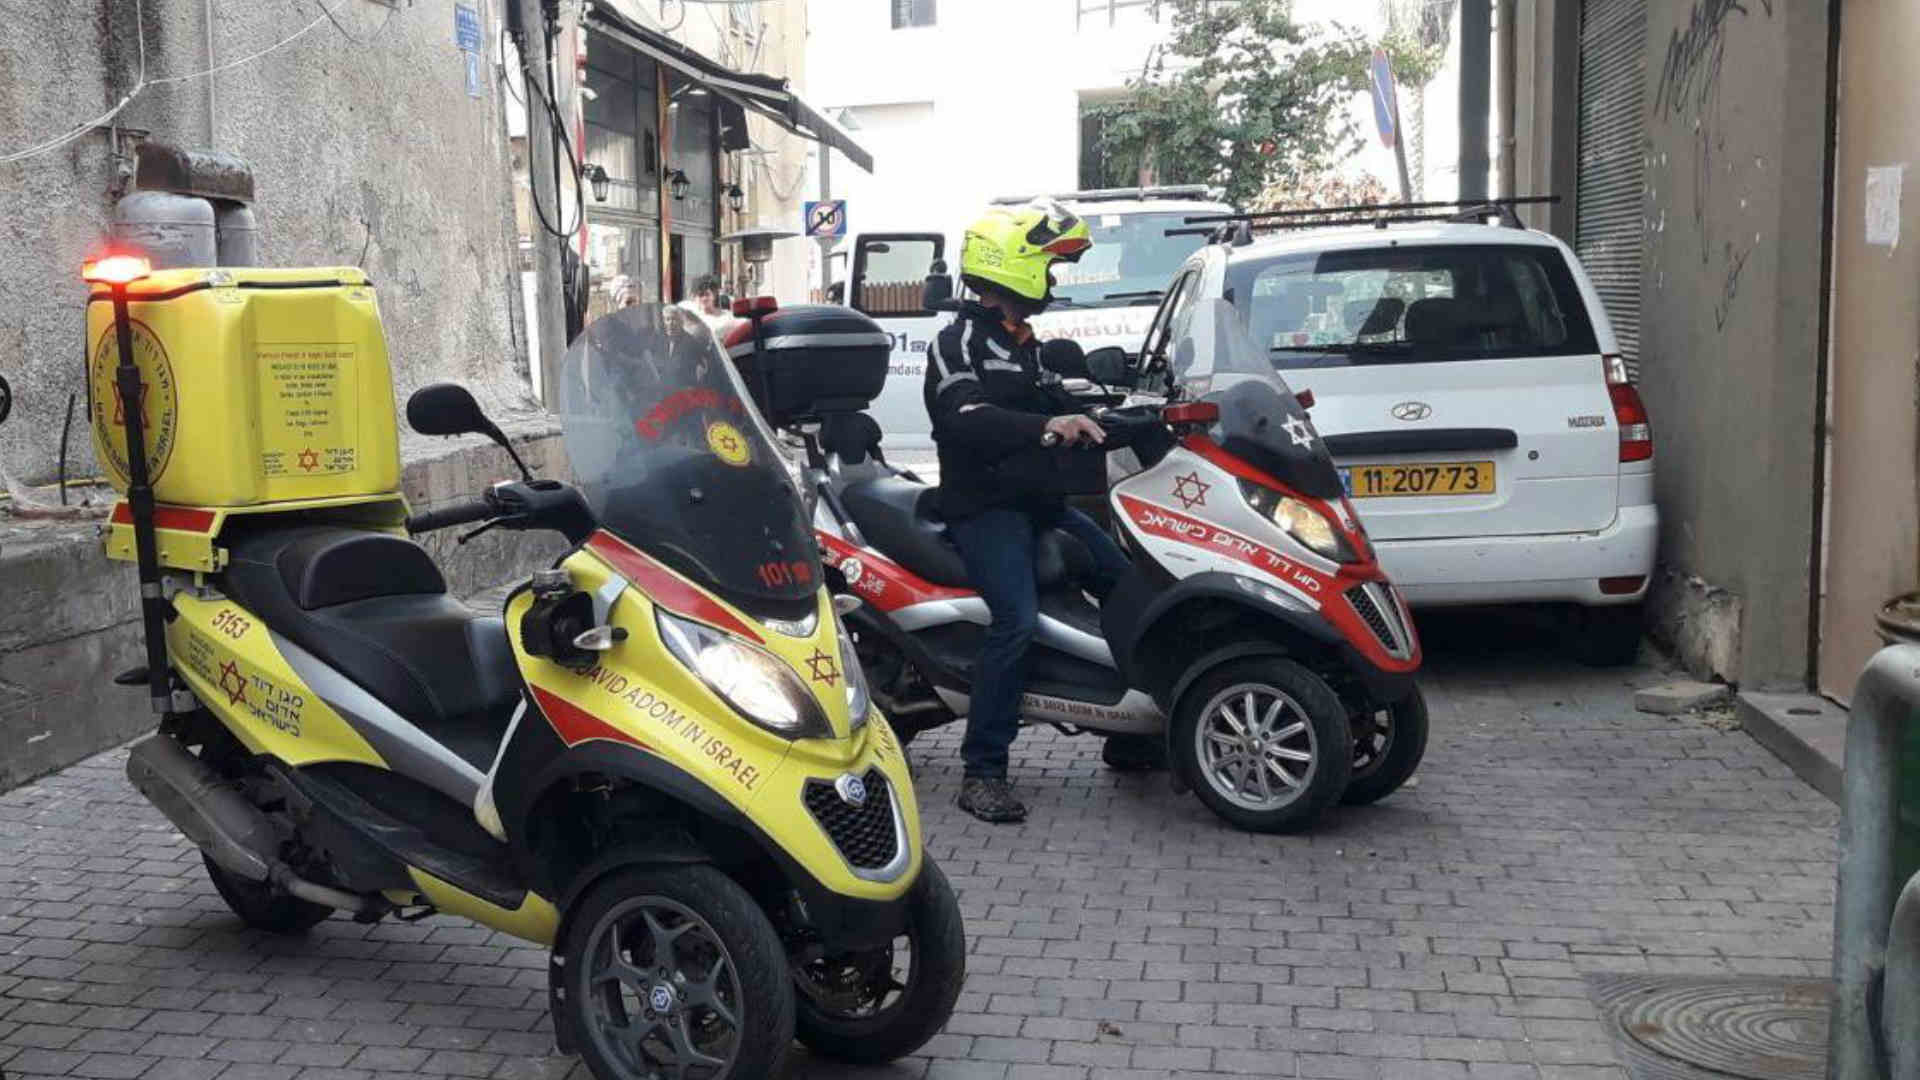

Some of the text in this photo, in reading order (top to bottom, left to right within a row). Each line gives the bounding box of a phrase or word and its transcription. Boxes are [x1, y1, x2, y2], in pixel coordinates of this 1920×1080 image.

[1140, 510, 1321, 592] מגן דוד אדום בישראל
[212, 608, 250, 639] 5153
[251, 674, 304, 708] מגן דוד
[266, 699, 300, 721] אדום
[623, 687, 687, 730] ADOM
[679, 721, 706, 745] IN
[701, 737, 761, 791] ISRAEL
